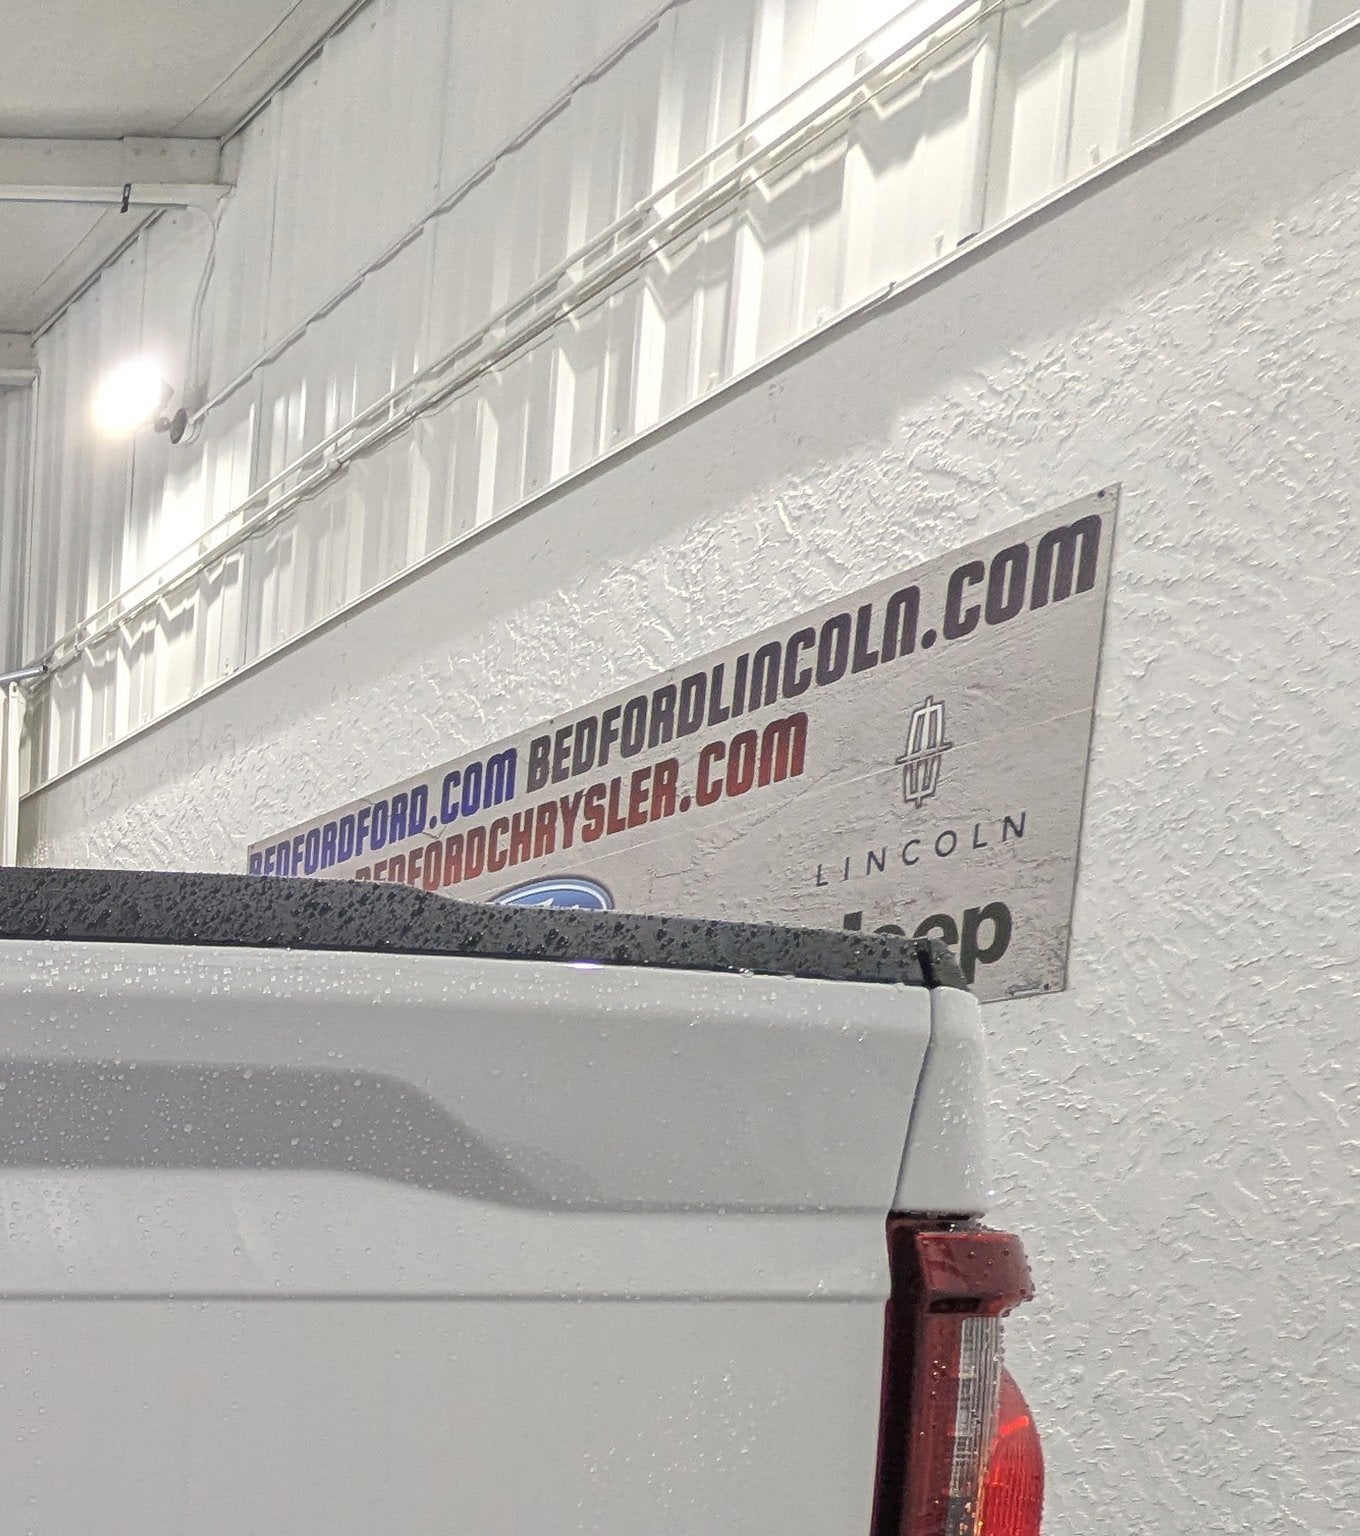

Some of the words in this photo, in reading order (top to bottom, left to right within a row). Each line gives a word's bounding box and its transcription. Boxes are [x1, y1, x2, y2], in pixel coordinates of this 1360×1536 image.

[249, 748, 517, 876] BEDFORDFORD.COM
[526, 514, 1102, 793] BEDFORDLINCOLN.COM
[816, 812, 1026, 887] LINCOLN
